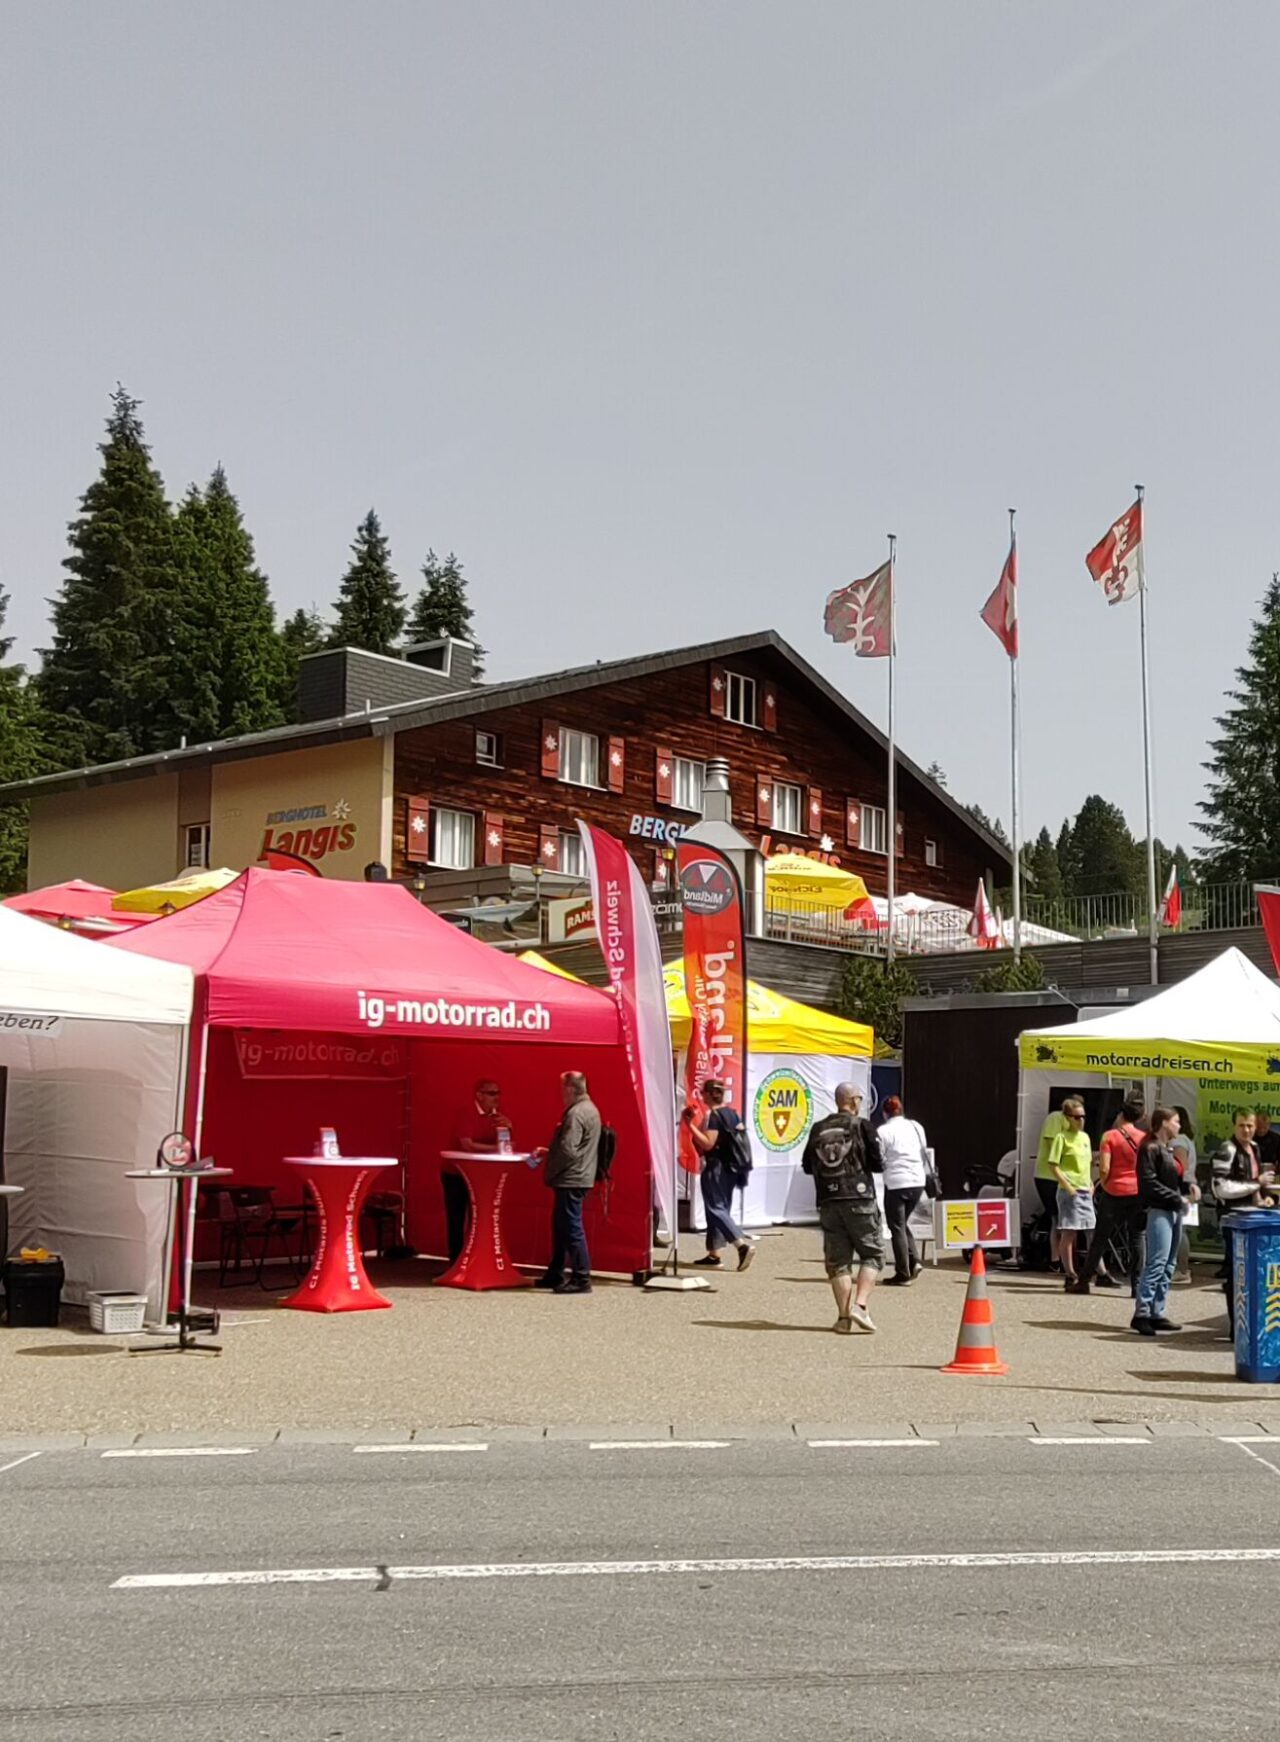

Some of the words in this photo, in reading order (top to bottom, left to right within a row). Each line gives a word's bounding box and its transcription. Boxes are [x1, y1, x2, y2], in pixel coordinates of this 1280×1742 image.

[266, 804, 328, 825] BERGHOTEL
[257, 823, 357, 862] Langis
[357, 991, 550, 1030] ig-motorrad.ch
[240, 1038, 399, 1066] ig-motorrad.ch
[1087, 1053, 1233, 1073] motorradreisen.ch
[768, 1089, 798, 1107] SAM
[1200, 1078, 1259, 1094] Unterwegs
[345, 1215, 355, 1273] Motorrad
